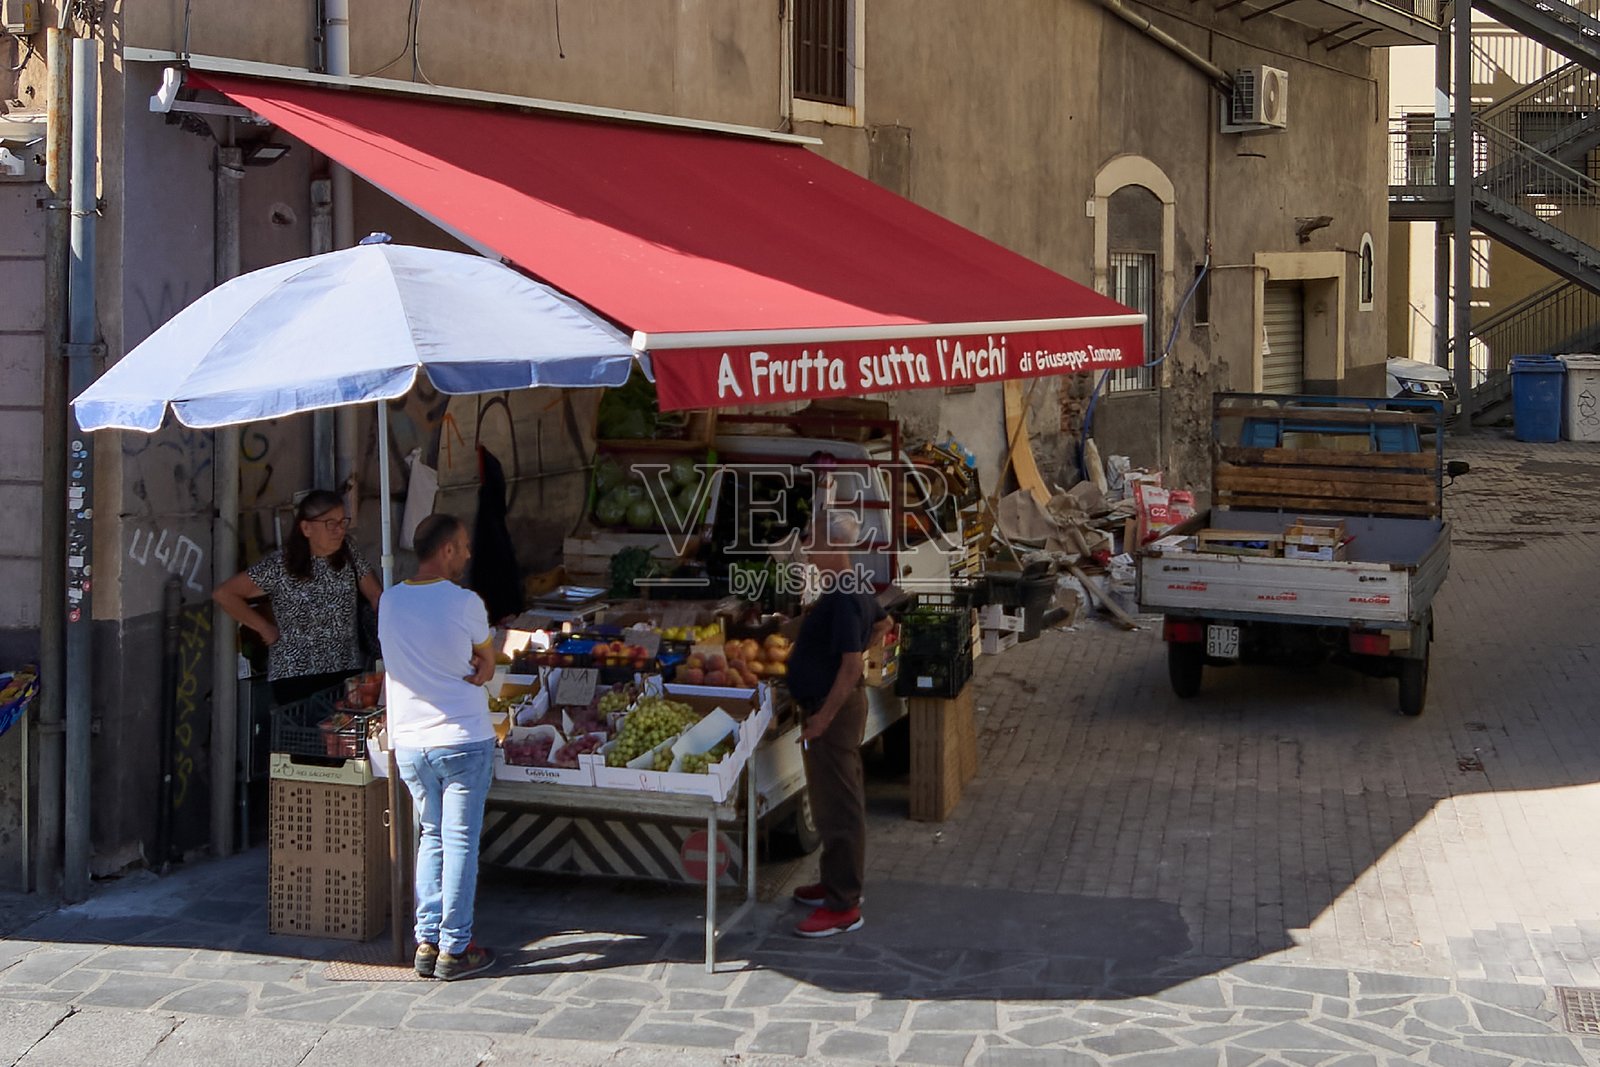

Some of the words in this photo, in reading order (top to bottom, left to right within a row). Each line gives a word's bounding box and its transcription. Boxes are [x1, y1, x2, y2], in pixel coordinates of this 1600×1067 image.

[717, 352, 743, 399] A
[750, 349, 847, 397] Frutta
[858, 345, 931, 388] sutta
[936, 335, 1007, 381] l'Archi
[1019, 351, 1033, 372] di
[1035, 349, 1089, 371] Giuseppe
[1151, 507, 1167, 517] C2
[560, 668, 589, 684] UVA
